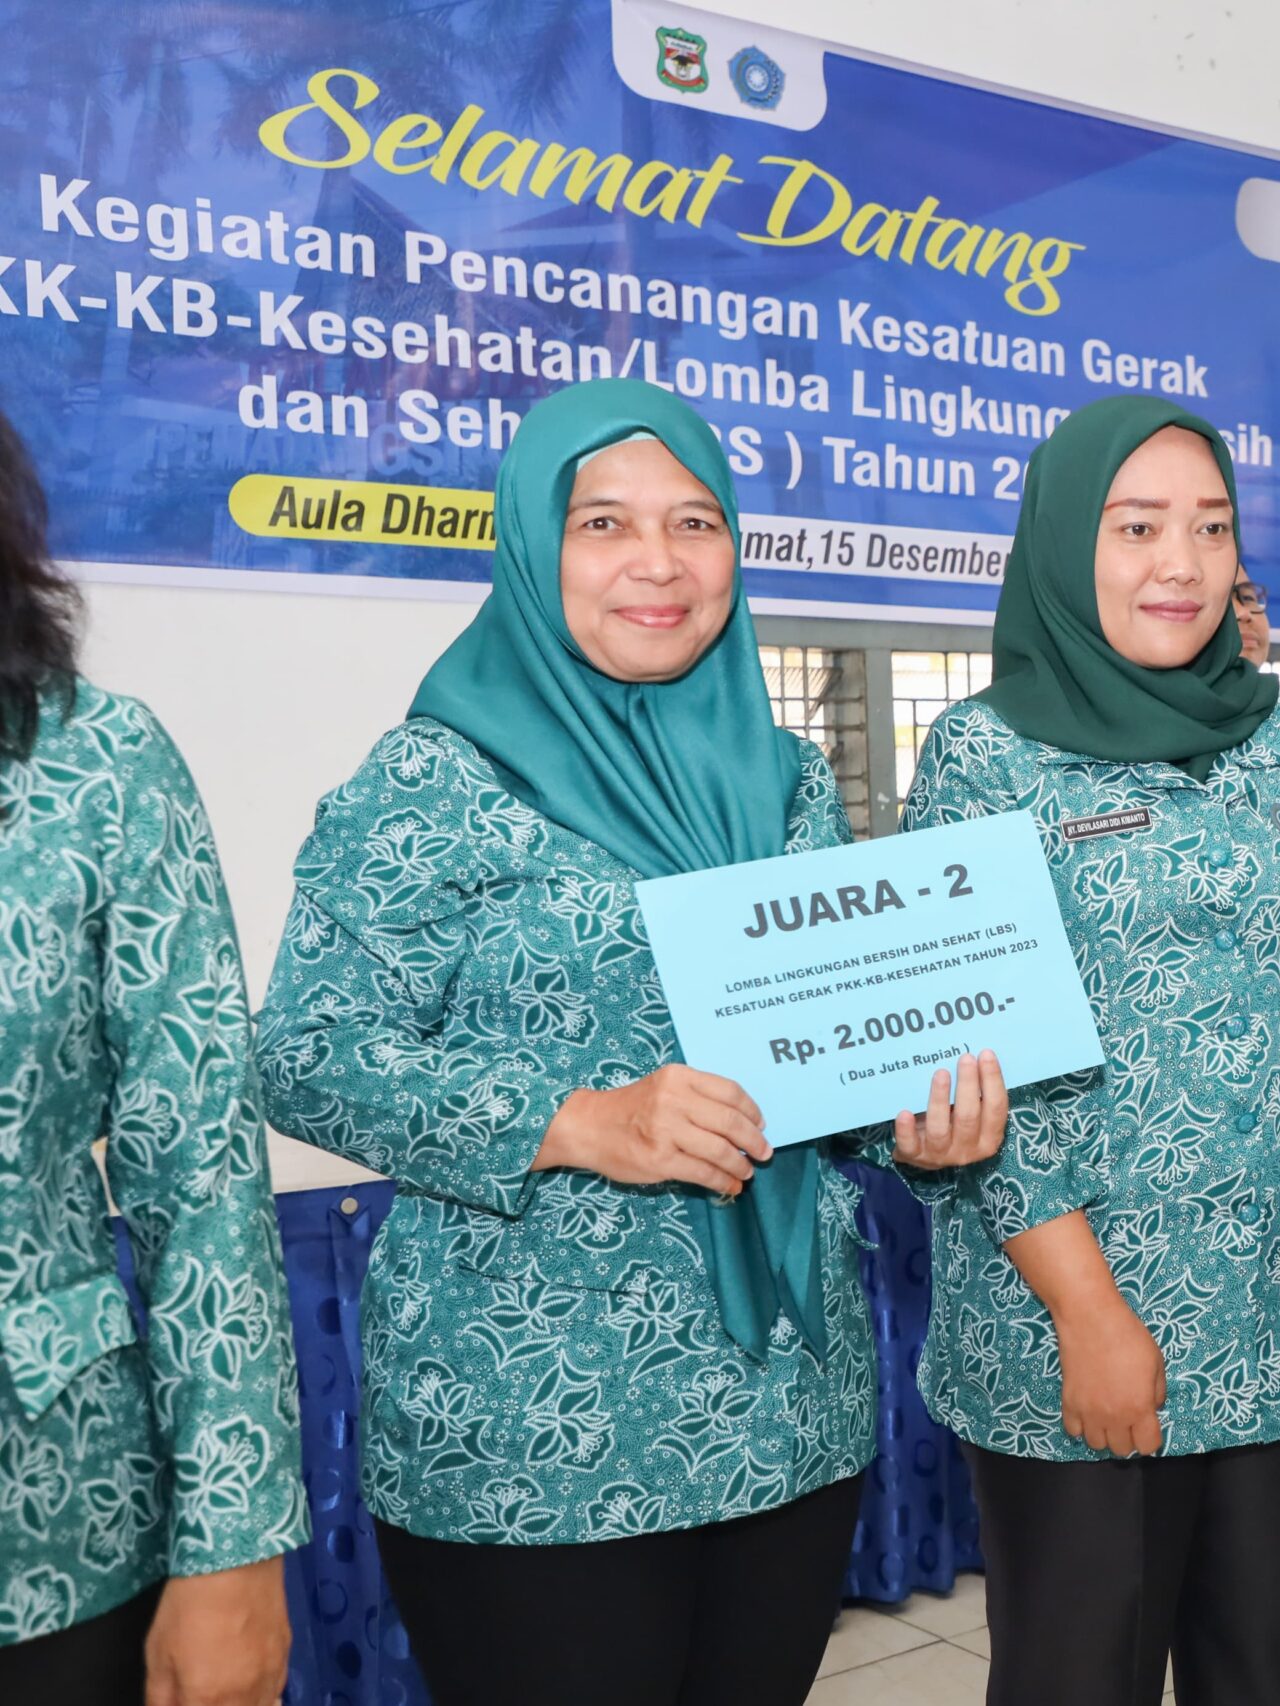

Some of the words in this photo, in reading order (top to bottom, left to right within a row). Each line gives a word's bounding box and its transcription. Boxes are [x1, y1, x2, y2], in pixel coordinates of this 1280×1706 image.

[258, 68, 744, 229] Selamat
[736, 154, 1086, 316] Datang
[40, 173, 375, 278] Kegiatan
[405, 230, 818, 341] Pencanangan
[838, 299, 1065, 377] Kesatuan
[1082, 339, 1208, 398] Gerak
[238, 374, 368, 437] dan
[398, 389, 521, 450] Seh
[823, 436, 976, 497] Tahun
[1217, 423, 1272, 467] sih
[268, 485, 366, 533] Aula
[743, 879, 906, 939] JUARA
[917, 887, 931, 897] -
[943, 863, 973, 899] 2
[715, 995, 785, 1018] KESATUAN
[789, 984, 833, 1004] GERAK
[836, 956, 961, 993] PKK-KB-KESEHATAN
[963, 945, 1006, 964] TAHUN
[1010, 938, 1038, 954] 2023
[726, 976, 772, 993] LOMBA
[774, 957, 860, 984] LINGKUNGAN
[863, 946, 910, 965] BERSIH
[912, 939, 939, 955] DAN
[942, 930, 981, 947] SEHAT
[985, 922, 1017, 939] (LBS)
[769, 1038, 826, 1065] Rp.
[833, 991, 1015, 1051] 2.000.000.-
[848, 1063, 875, 1082] Dua
[879, 1057, 909, 1075] Juta
[912, 1046, 961, 1066] Rupiah
